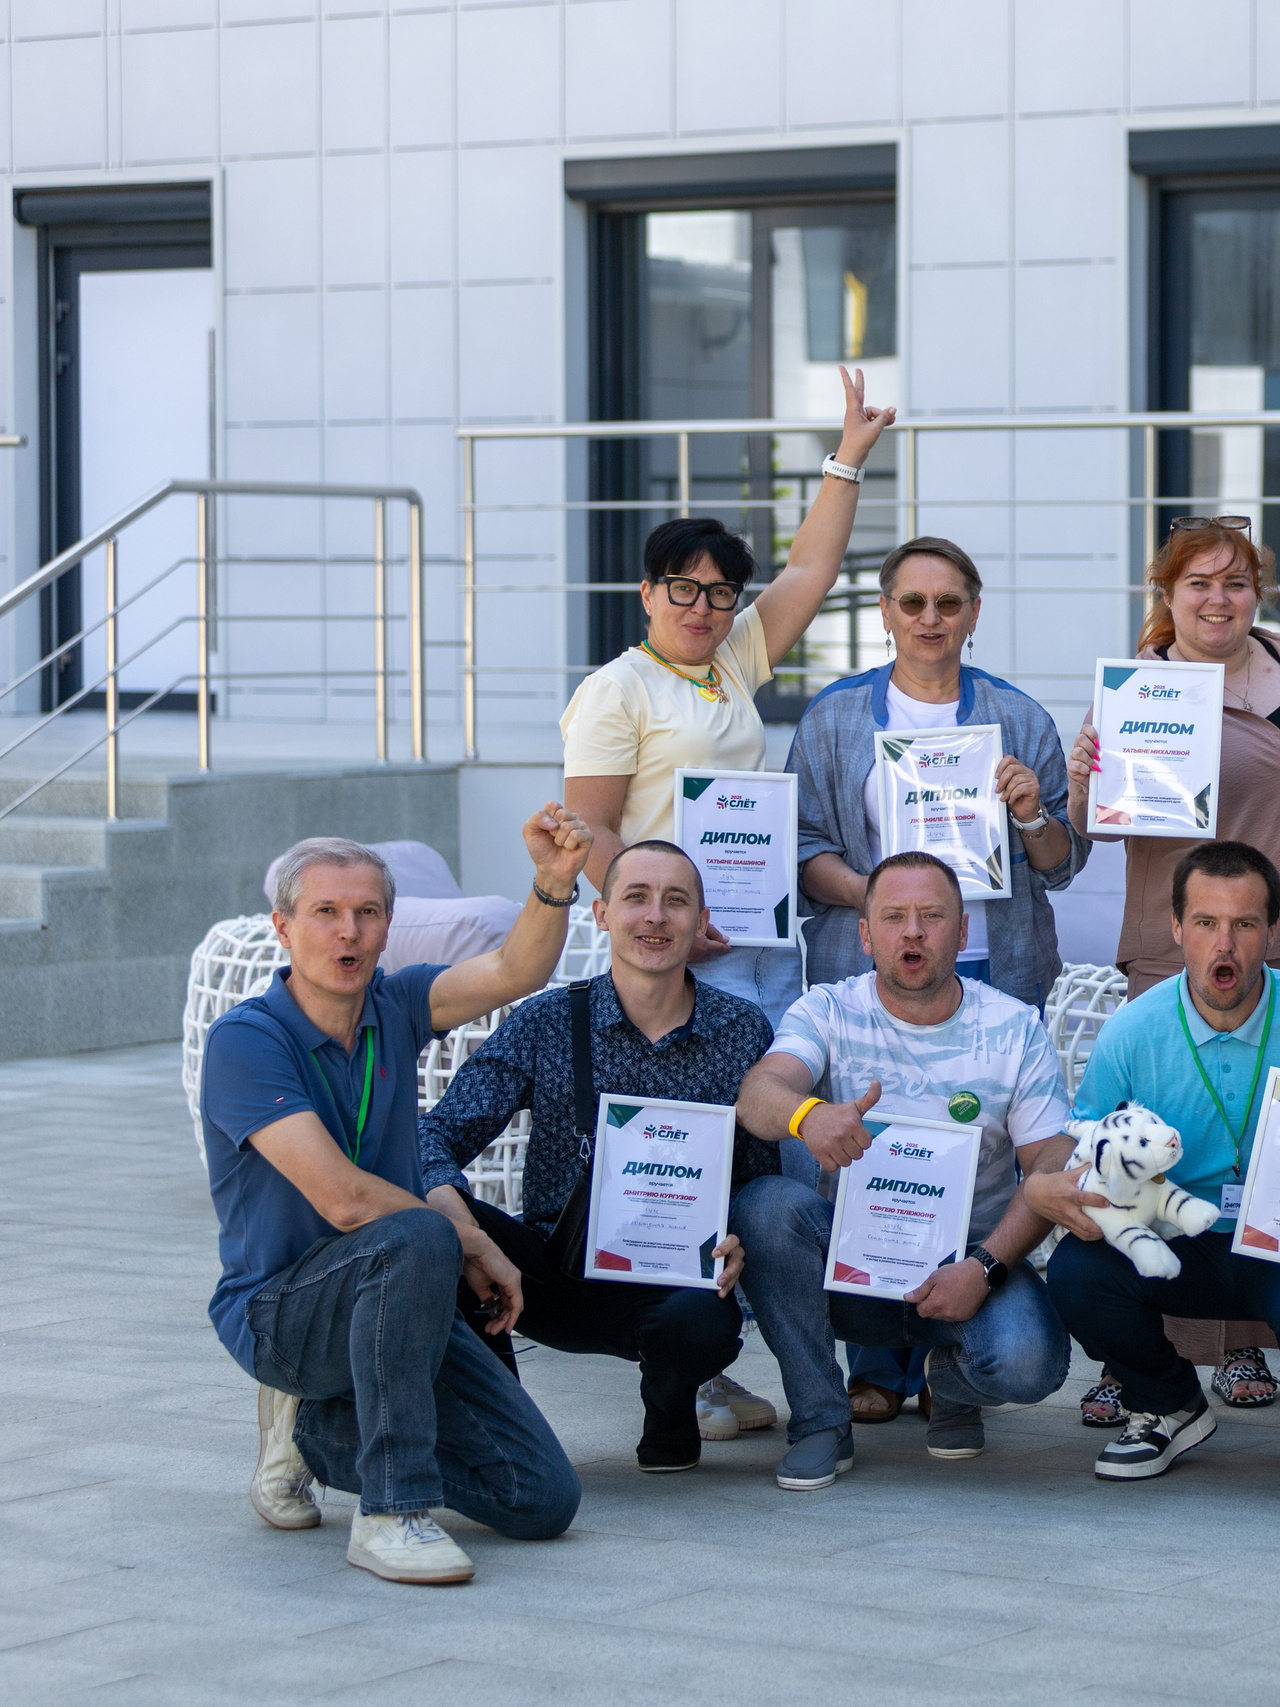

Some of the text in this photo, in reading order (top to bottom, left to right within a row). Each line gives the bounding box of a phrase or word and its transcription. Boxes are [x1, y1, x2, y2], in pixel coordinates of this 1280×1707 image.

[1152, 688, 1181, 698] СЛЁТ
[1119, 721, 1194, 735] ДИПЛОМ
[932, 756, 960, 764] СЛЁТ
[905, 788, 978, 805] ДИПЛОМ
[730, 799, 756, 808] СЛЁТ
[700, 831, 771, 845] ДИПЛОМ
[658, 1129, 689, 1140] СЛЁТ
[904, 1146, 934, 1159] СЛЁТ
[622, 1161, 702, 1179] ДИПЛОМ
[866, 1177, 945, 1198] ДИПЛОМ
[660, 1192, 698, 1201] КУРГУЗОВУ
[870, 1205, 895, 1213] СЕРГЕЮ
